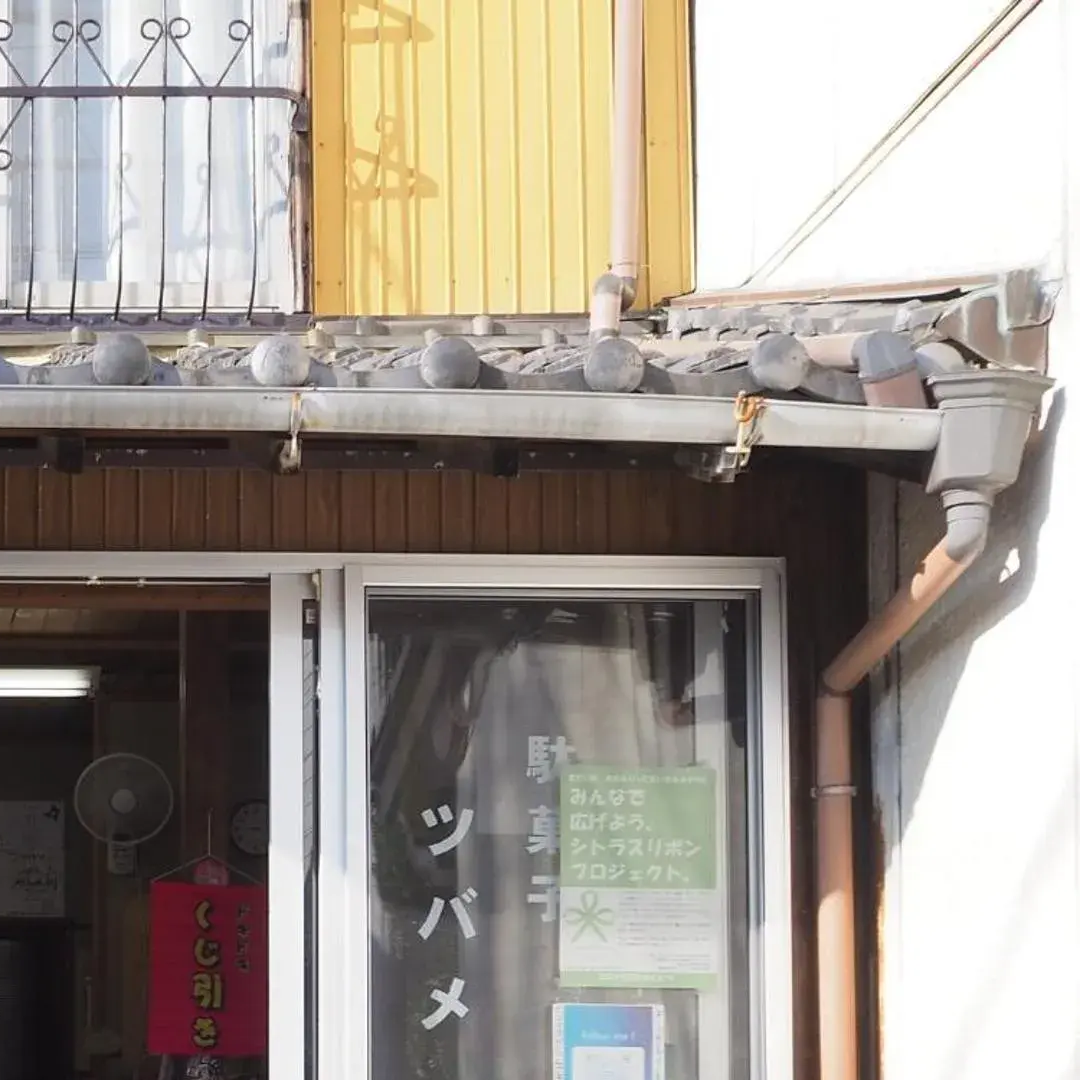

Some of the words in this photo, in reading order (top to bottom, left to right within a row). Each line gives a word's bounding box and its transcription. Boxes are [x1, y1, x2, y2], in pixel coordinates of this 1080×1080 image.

[570, 788, 646, 806] みんなで
[191, 898, 226, 1051] くじ引き
[417, 803, 479, 1031] ツバメ
